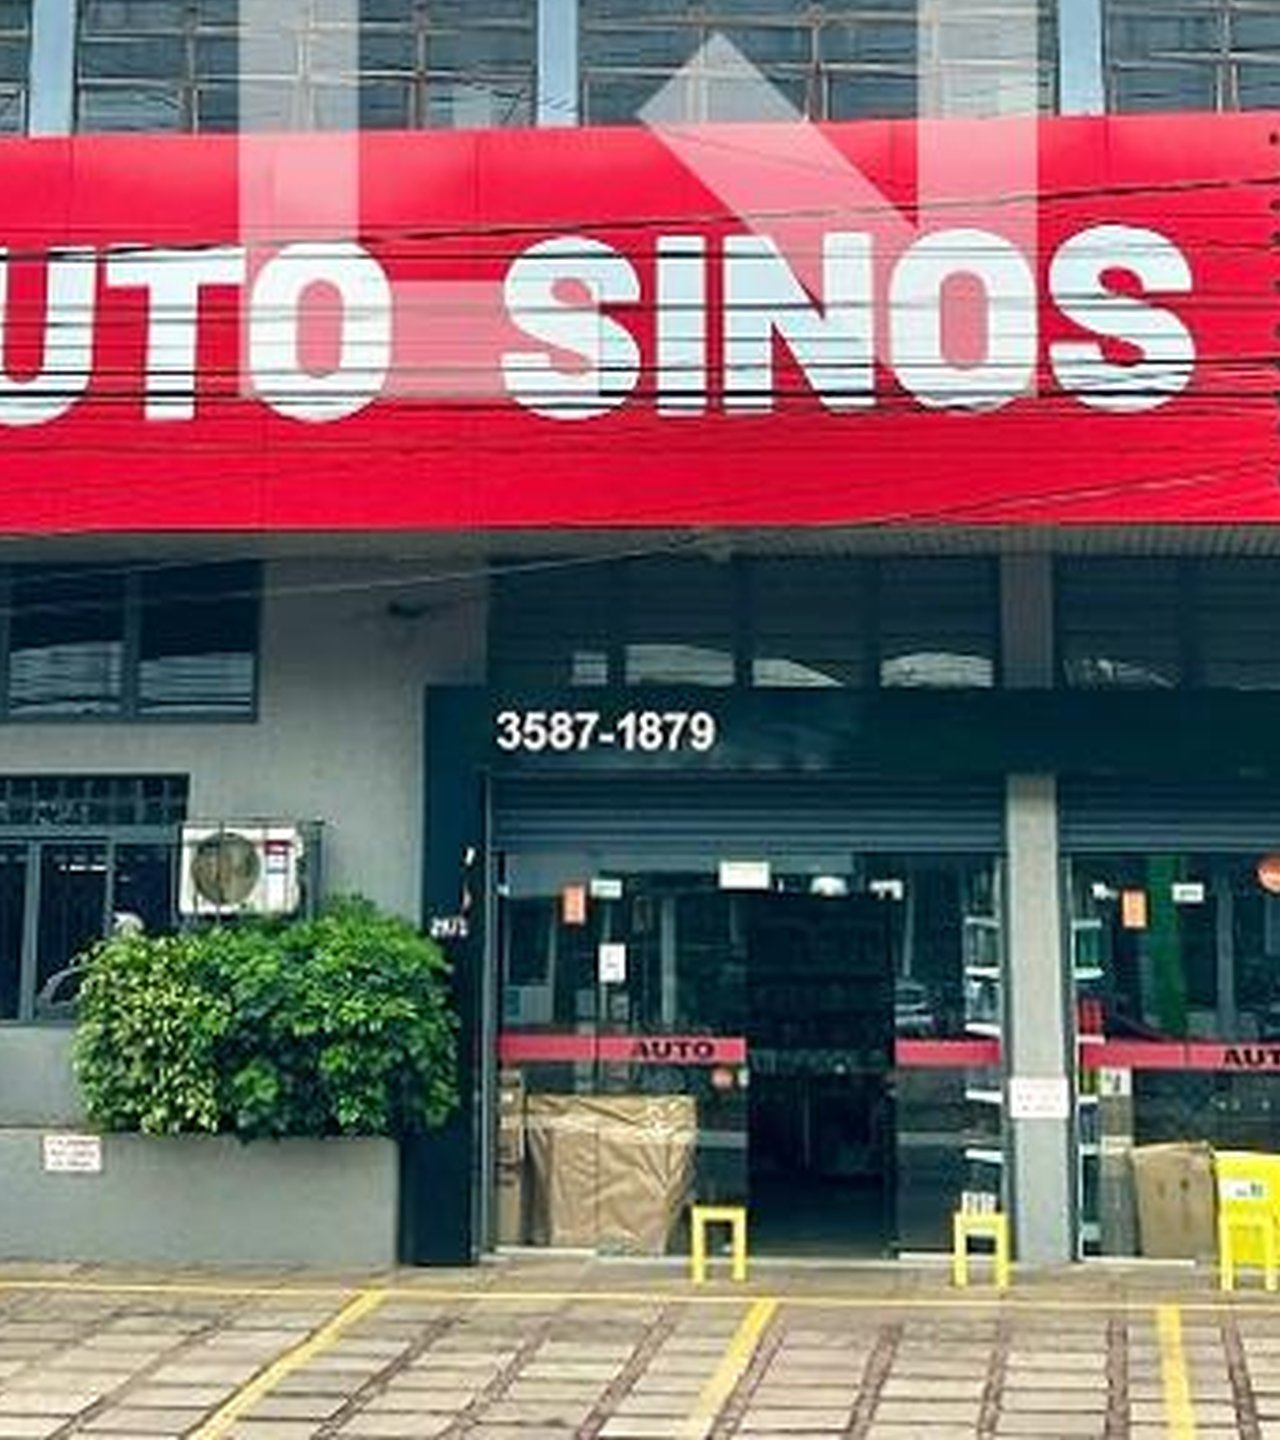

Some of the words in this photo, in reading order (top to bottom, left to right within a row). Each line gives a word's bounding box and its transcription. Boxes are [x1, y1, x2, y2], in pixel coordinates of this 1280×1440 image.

[500, 223, 1196, 420] SINOS
[496, 711, 715, 751] 3587-1879
[632, 1041, 715, 1059] AUTO
